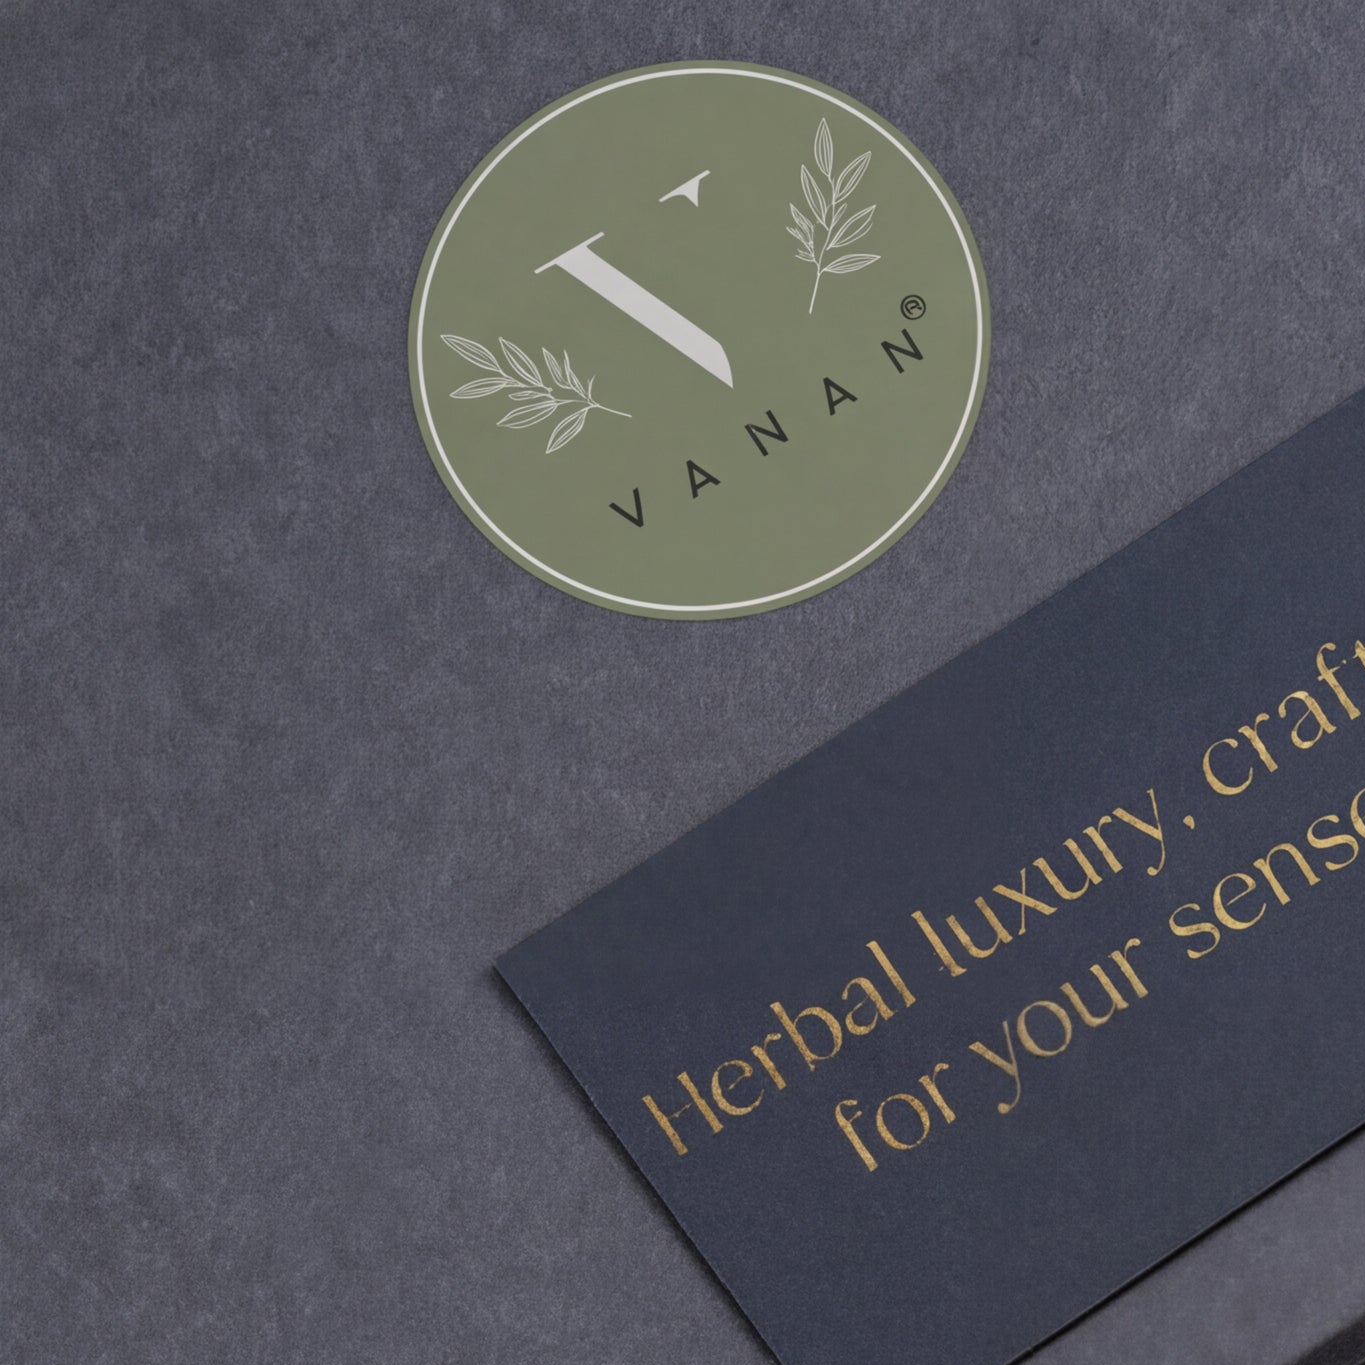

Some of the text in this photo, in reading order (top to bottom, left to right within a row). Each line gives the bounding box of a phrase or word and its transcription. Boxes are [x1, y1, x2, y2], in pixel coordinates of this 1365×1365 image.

[641, 939, 917, 1157] Herbal
[911, 788, 1197, 977] luxury,
[834, 1061, 957, 1173] for
[968, 937, 1149, 1115] your
